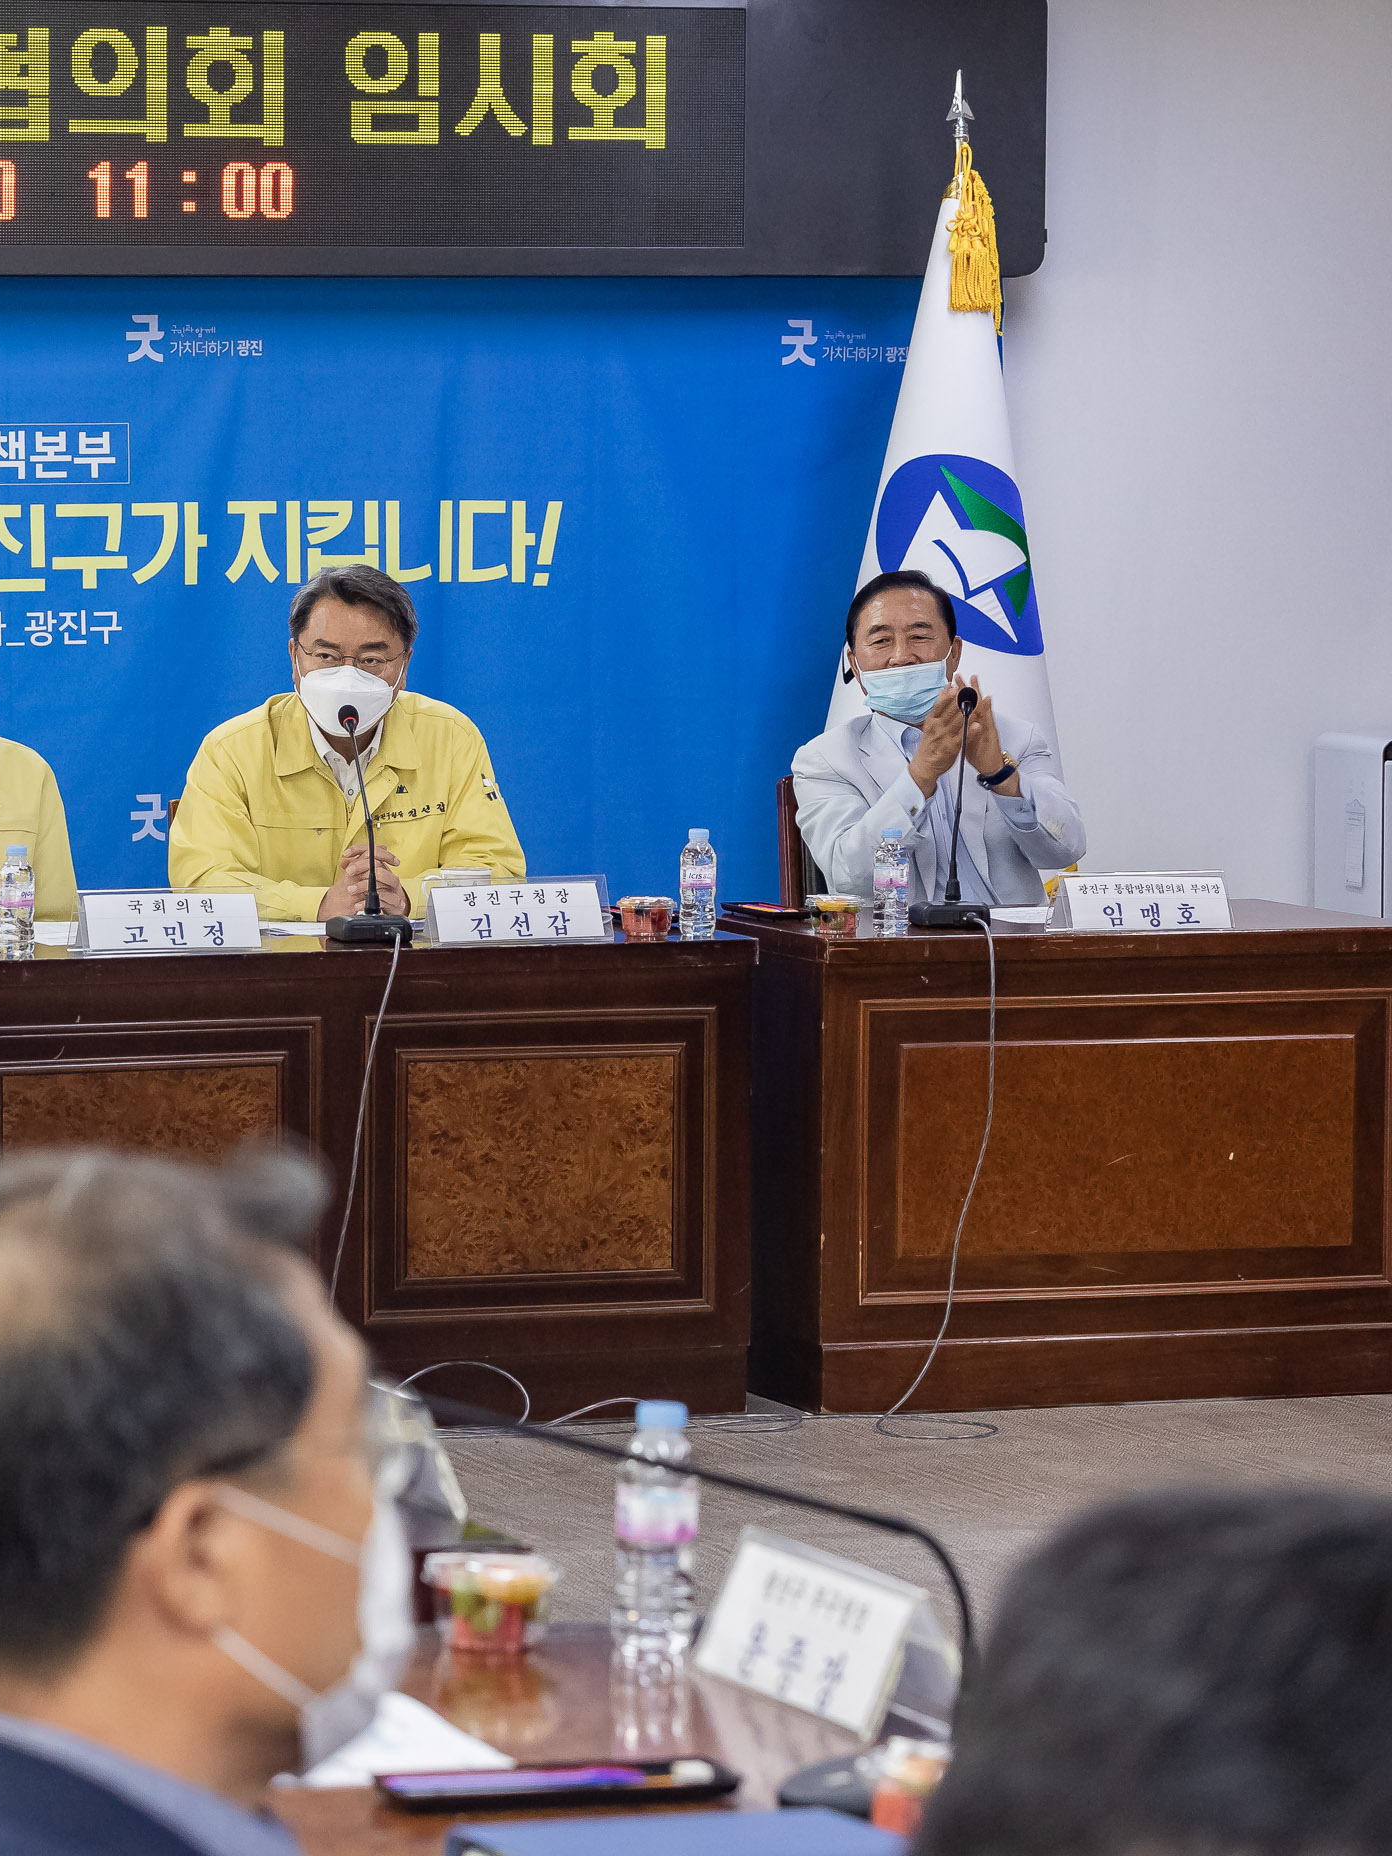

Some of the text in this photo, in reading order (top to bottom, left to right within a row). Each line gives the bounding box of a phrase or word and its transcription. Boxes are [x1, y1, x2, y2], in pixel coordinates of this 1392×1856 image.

[344, 31, 667, 150] 임시회
[170, 339, 263, 357] 가치더하기 광진
[822, 347, 882, 362] 가치더하기
[226, 500, 563, 589] 지킵니다!
[463, 888, 569, 907] 광진구청장
[1078, 883, 1221, 895] 광진구 통합방위협의회 부의장
[127, 898, 215, 915] 국회의원
[1103, 902, 1201, 928] 임맹호
[123, 921, 225, 946] 고민정
[470, 911, 571, 939] 김선갑
